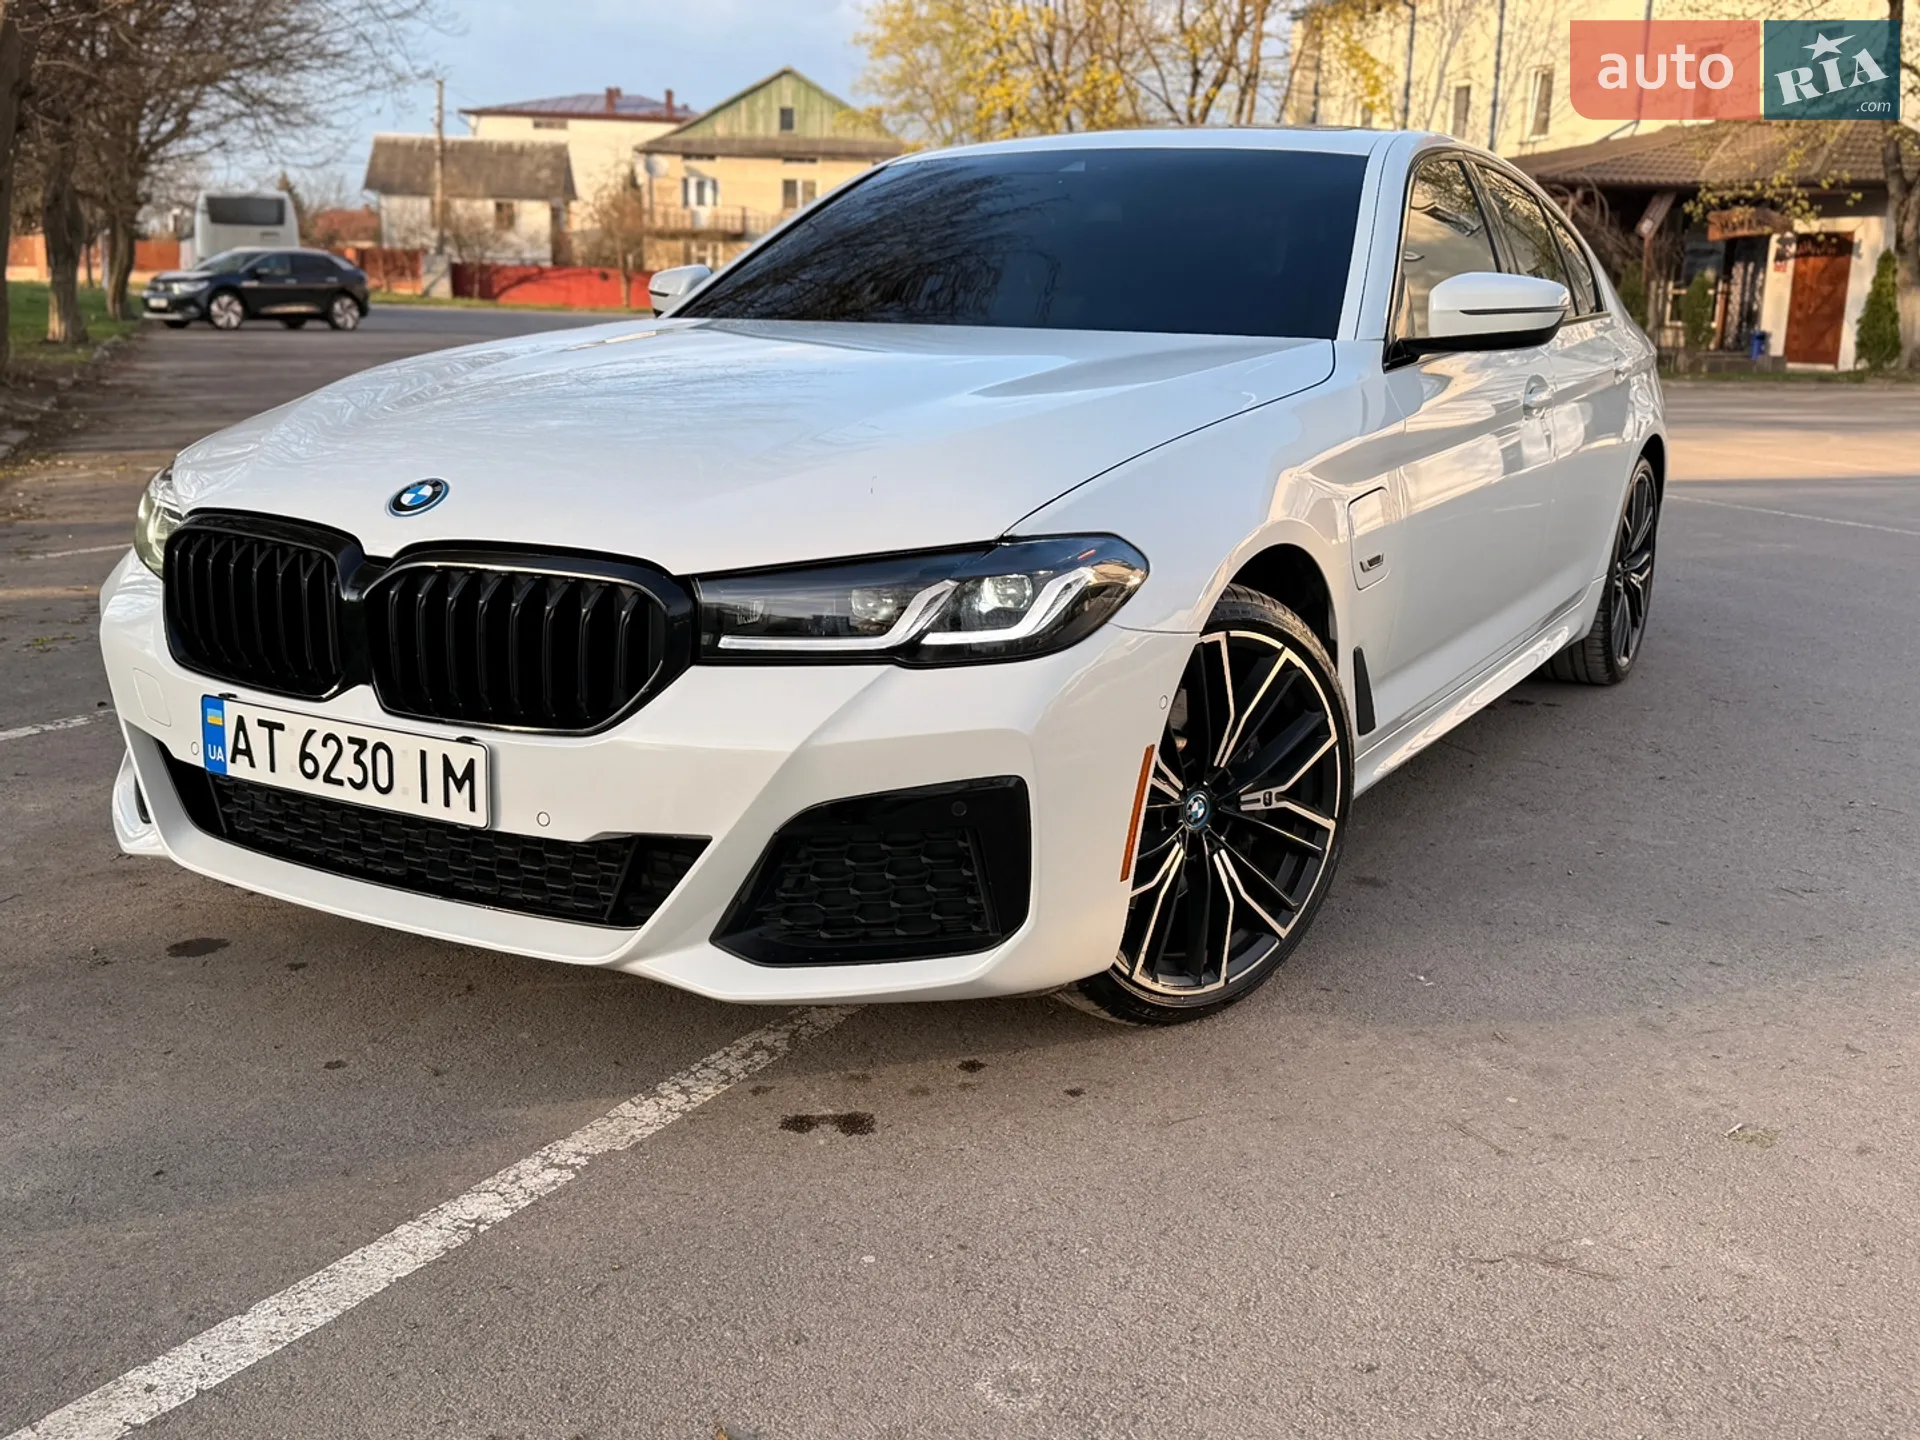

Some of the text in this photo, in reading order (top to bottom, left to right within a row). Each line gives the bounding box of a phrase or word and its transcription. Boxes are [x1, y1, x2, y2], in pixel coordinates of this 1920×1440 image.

[207, 743, 225, 763] UA
[229, 714, 477, 813] AT 6230 IM
